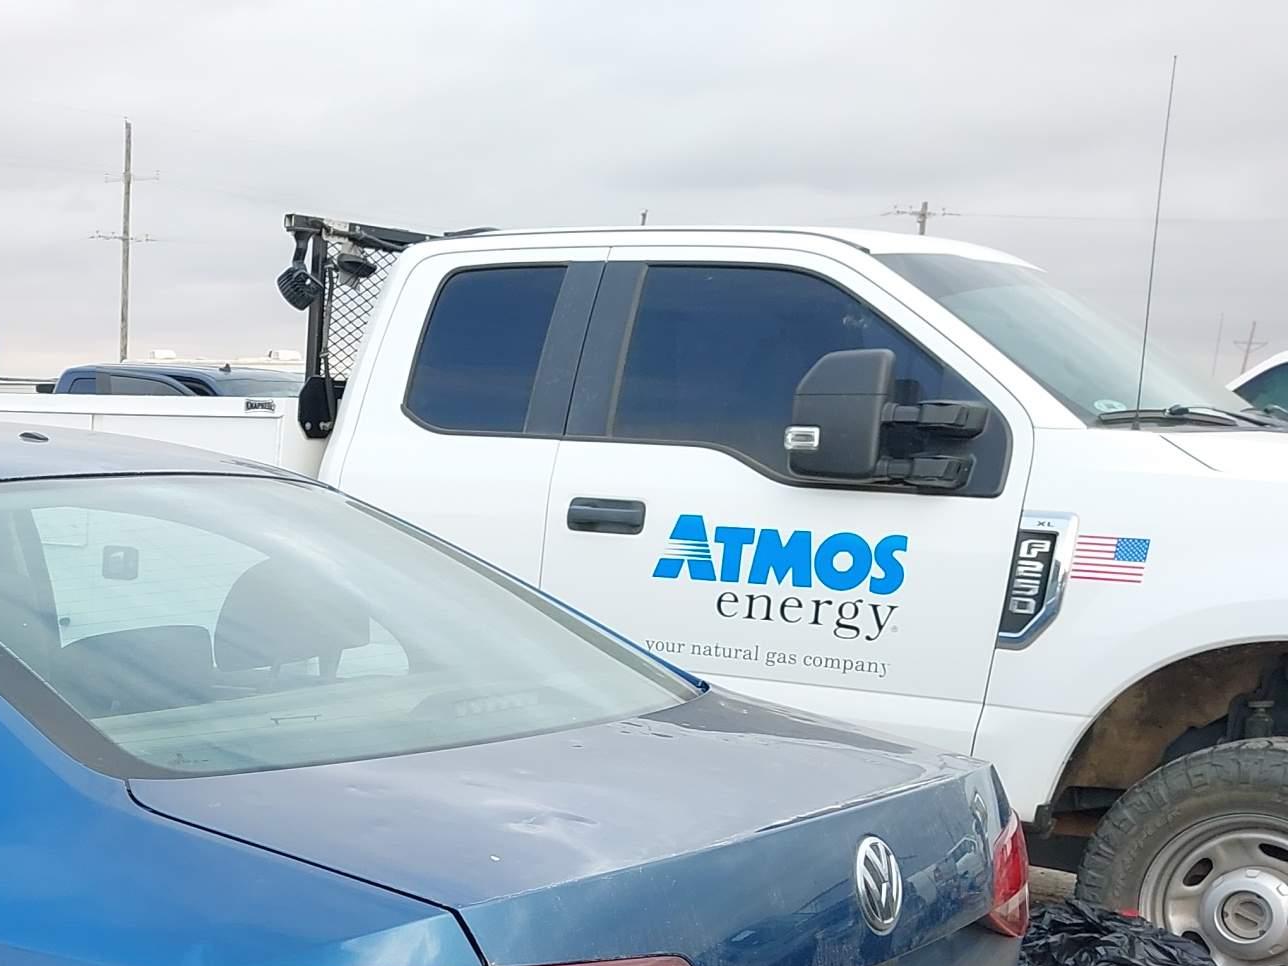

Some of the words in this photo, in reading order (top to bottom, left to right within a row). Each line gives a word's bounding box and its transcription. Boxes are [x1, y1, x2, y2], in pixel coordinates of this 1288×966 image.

[1037, 520, 1055, 528] XL
[652, 514, 908, 595] ATMOS
[716, 591, 899, 641] energy
[645, 638, 686, 654] your
[690, 644, 759, 661] natural
[765, 649, 797, 667] gas
[803, 654, 891, 678] company
